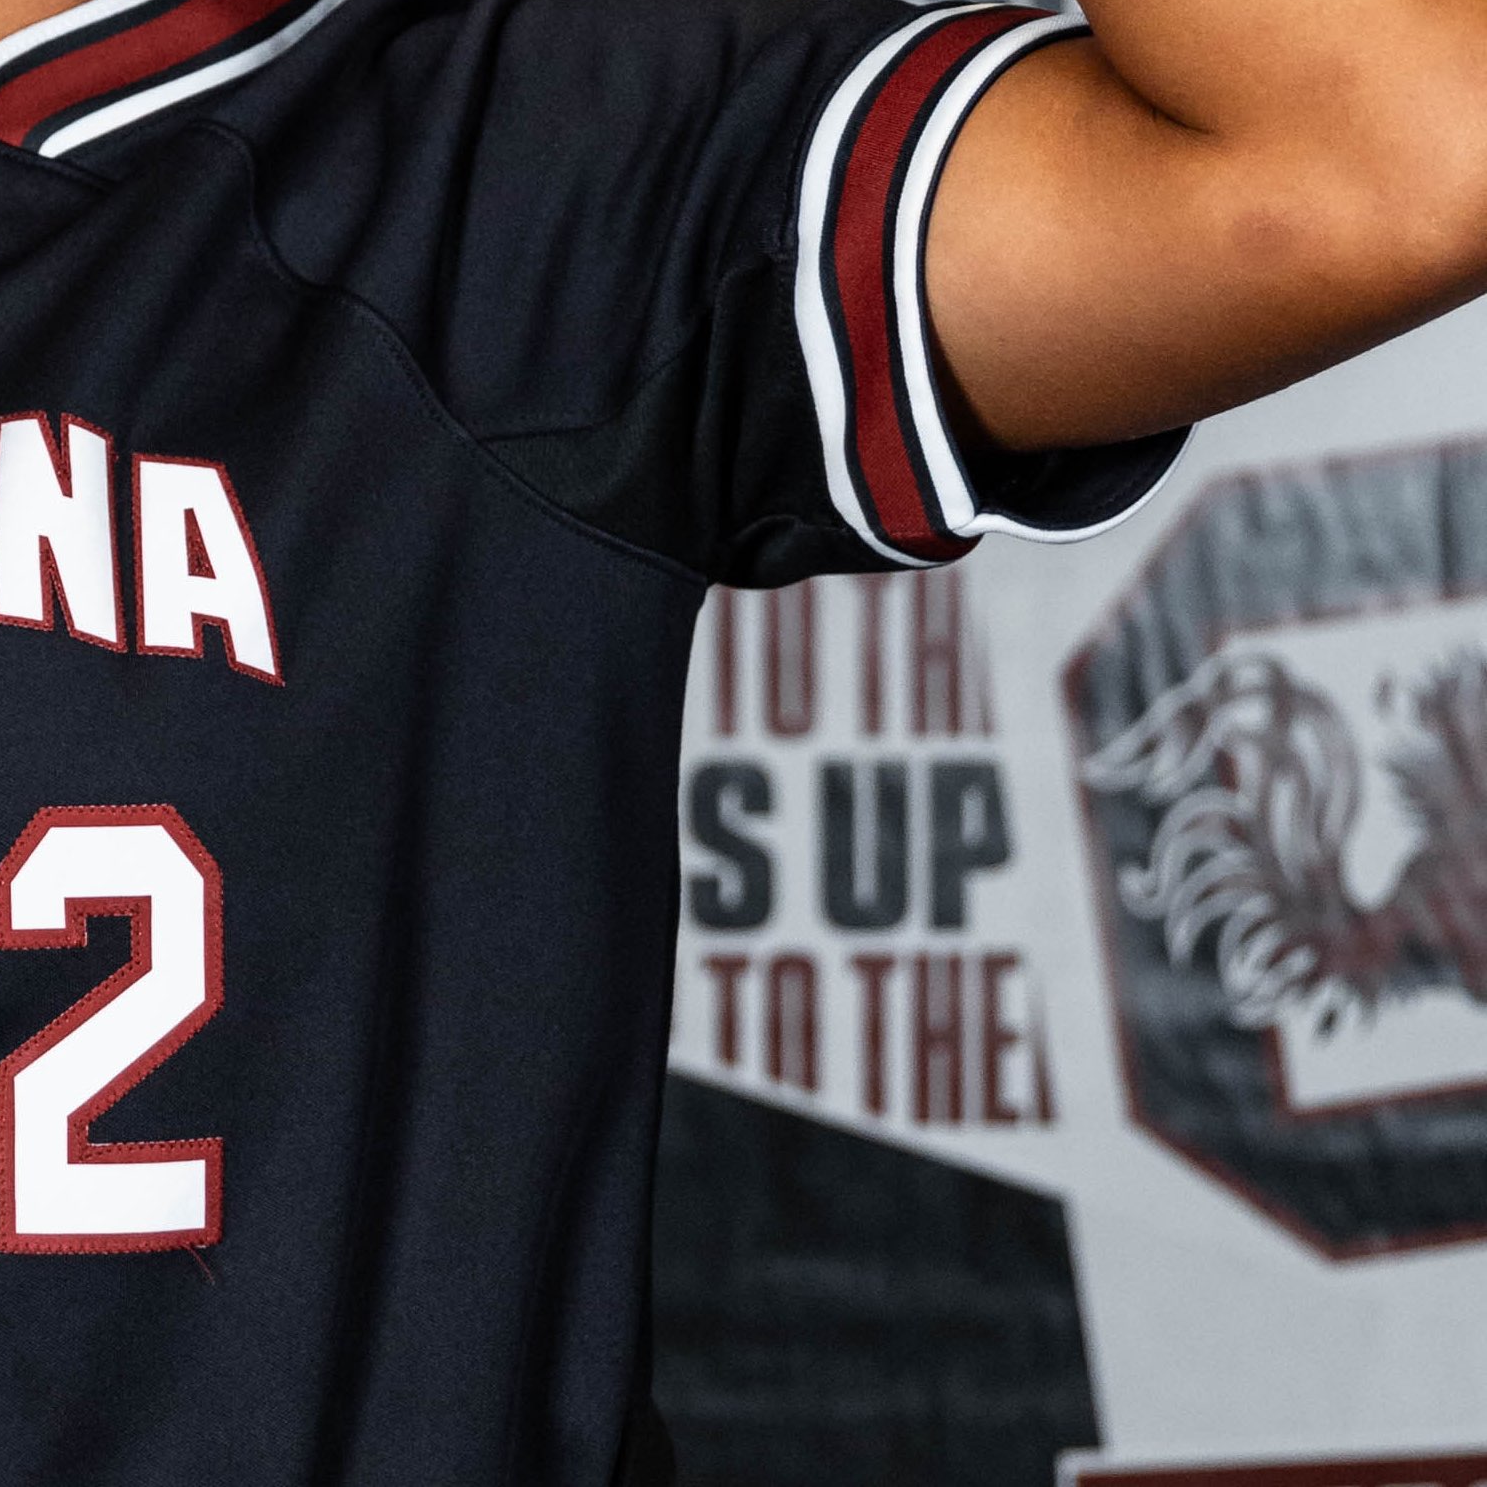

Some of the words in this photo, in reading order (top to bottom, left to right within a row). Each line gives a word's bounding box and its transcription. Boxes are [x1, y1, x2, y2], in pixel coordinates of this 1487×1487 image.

[822, 758, 1014, 930] UP
[702, 950, 817, 1092] TO
[848, 950, 1058, 1125] THE
